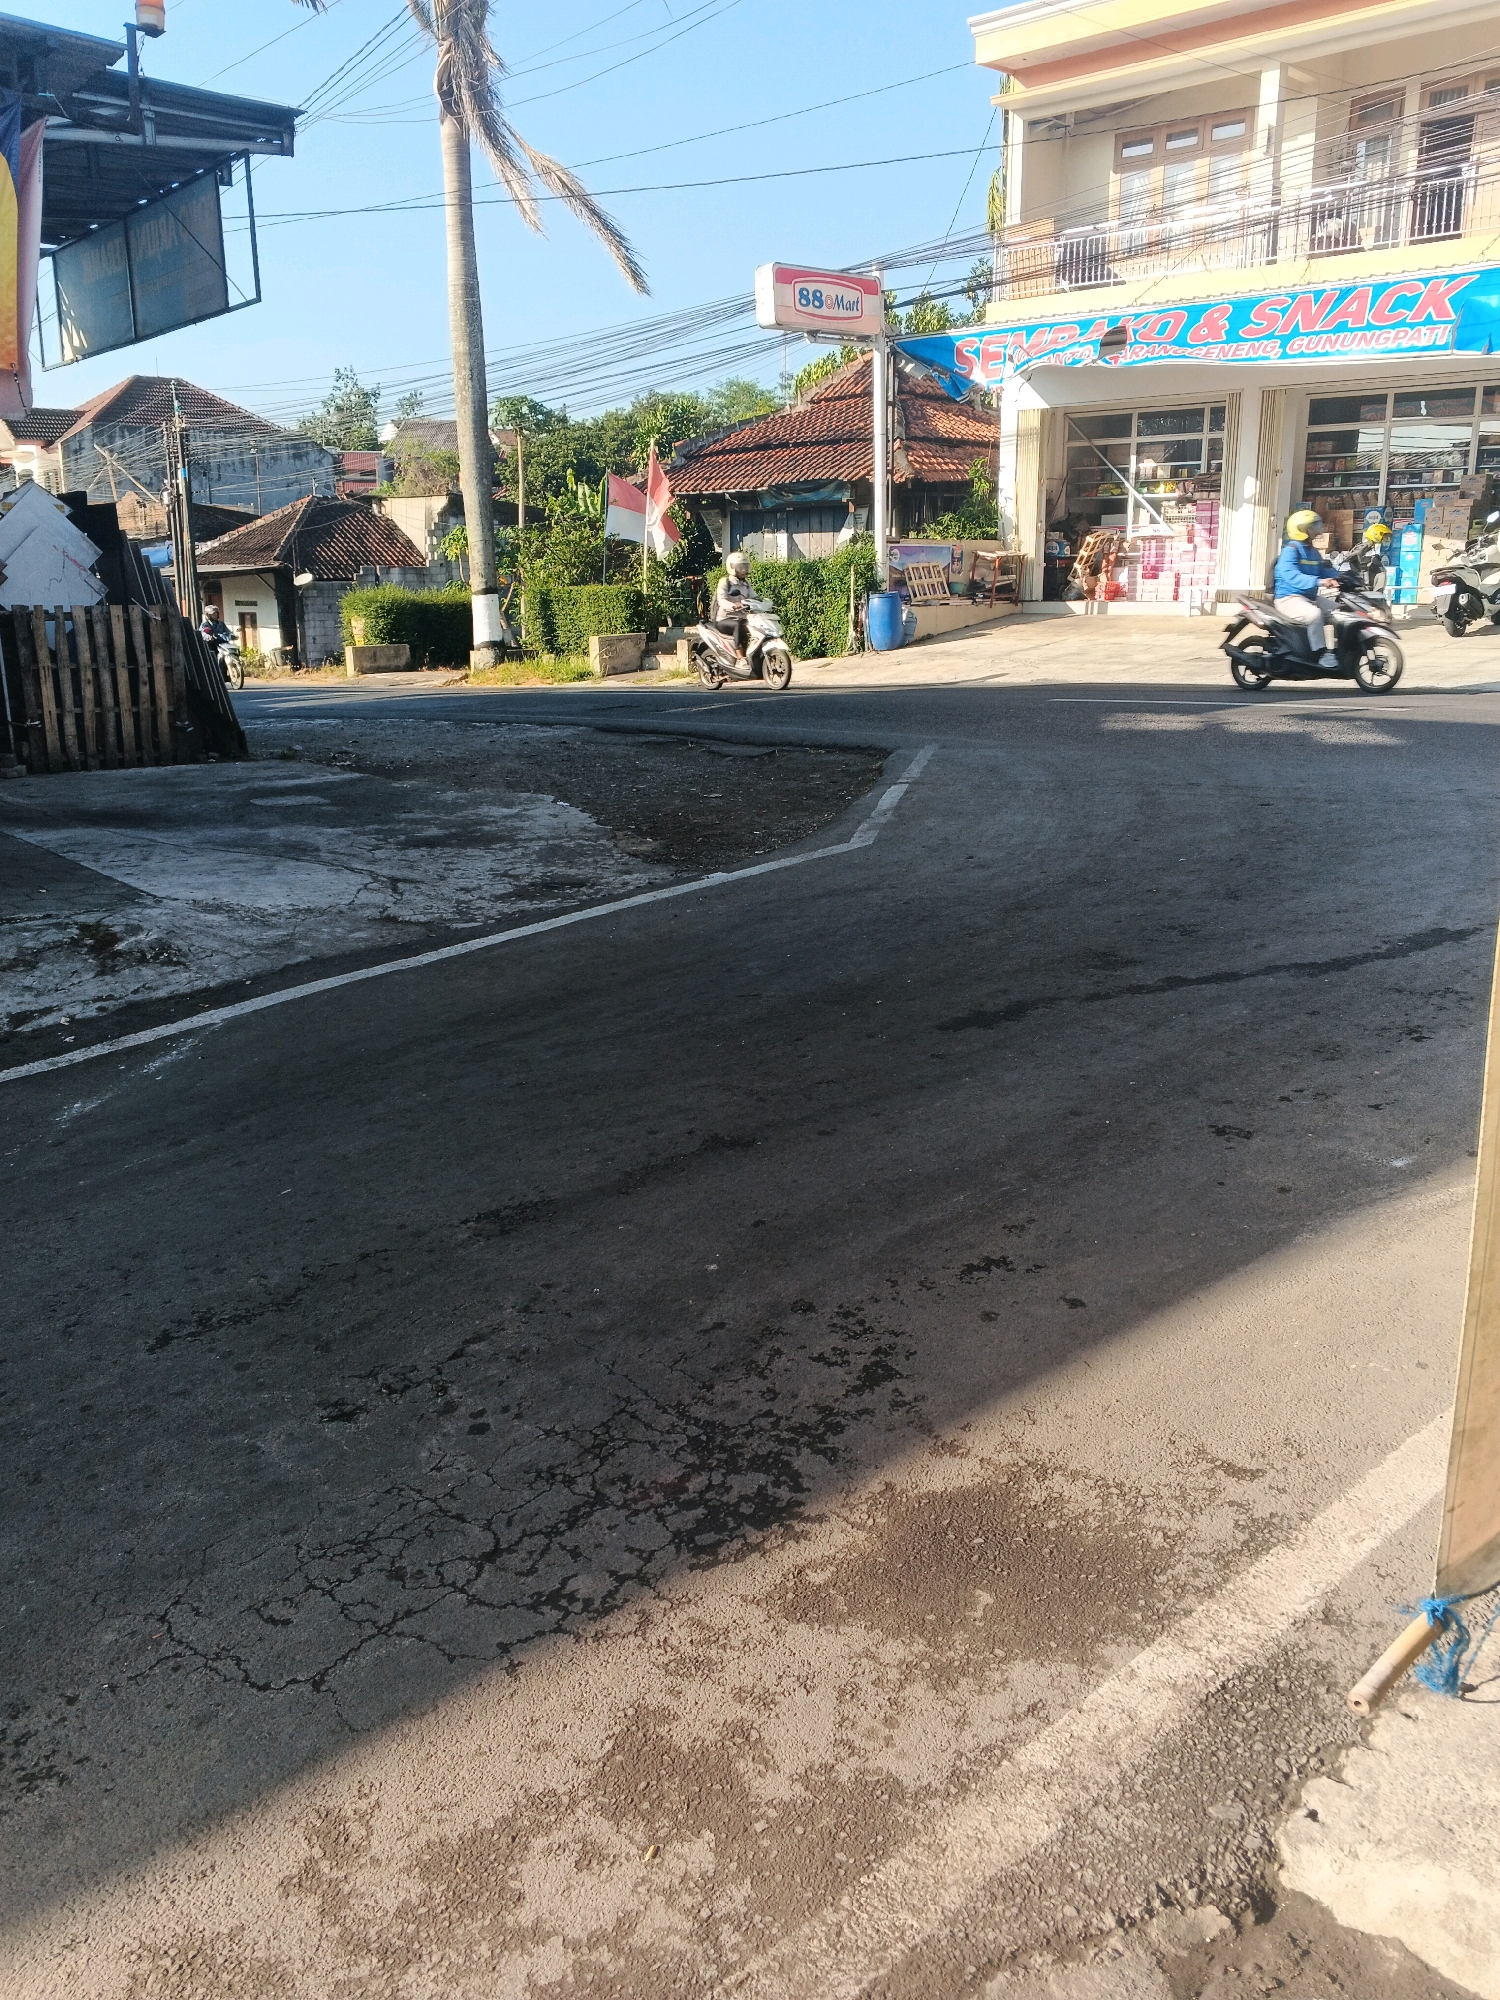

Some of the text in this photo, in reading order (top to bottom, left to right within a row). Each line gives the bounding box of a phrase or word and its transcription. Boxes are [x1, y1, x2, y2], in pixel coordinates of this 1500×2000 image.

[798, 287, 860, 312] 88 Mart
[1188, 304, 1231, 344] &
[1240, 274, 1481, 339] SNACK
[1286, 324, 1452, 354] GUNUNGPATI
